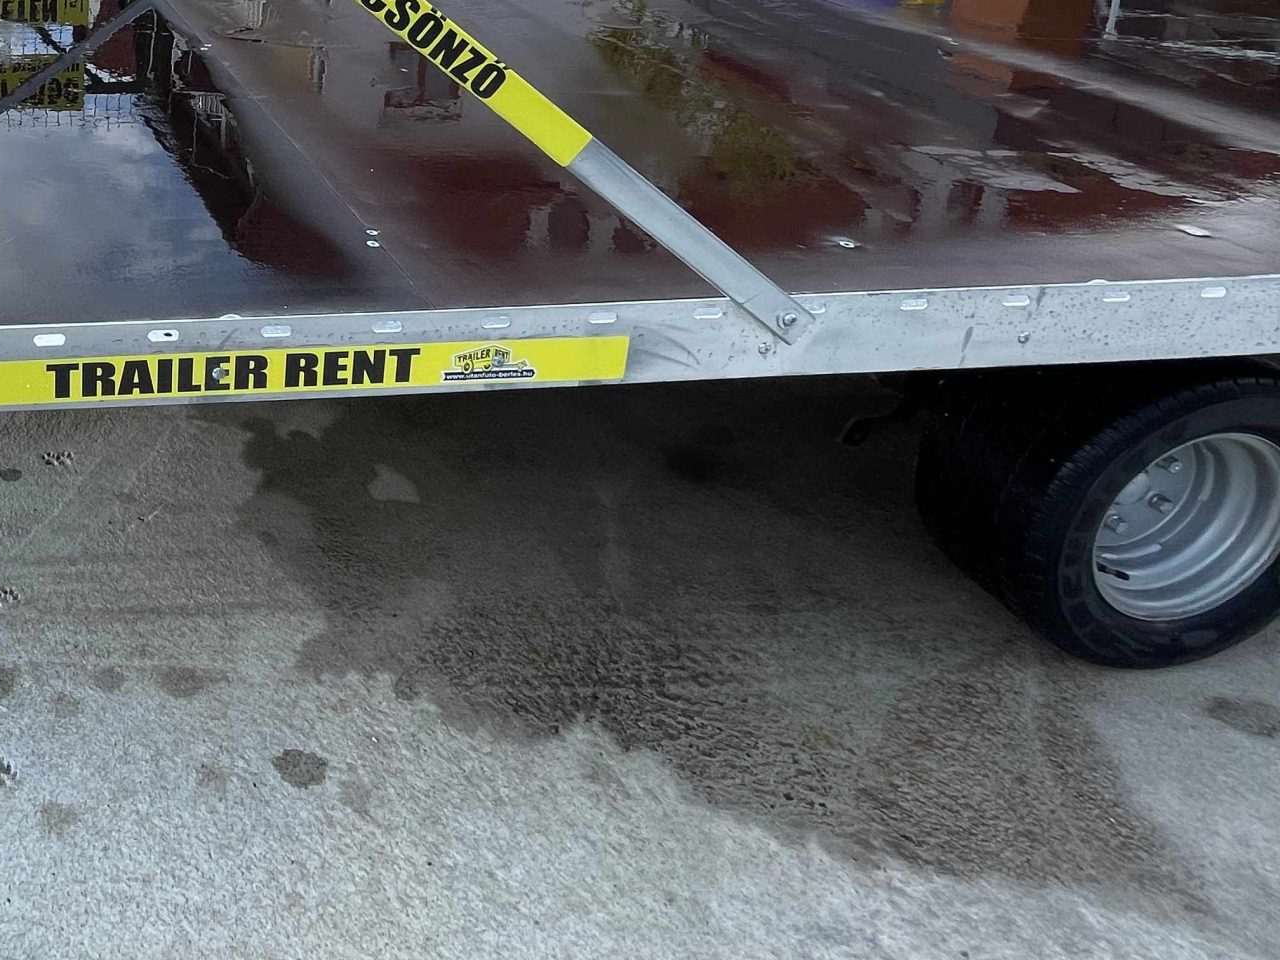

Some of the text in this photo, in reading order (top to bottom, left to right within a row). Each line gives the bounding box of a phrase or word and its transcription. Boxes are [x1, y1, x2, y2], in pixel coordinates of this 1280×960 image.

[457, 348, 491, 363] TRAILER
[46, 348, 421, 398] TRAILER RENT
